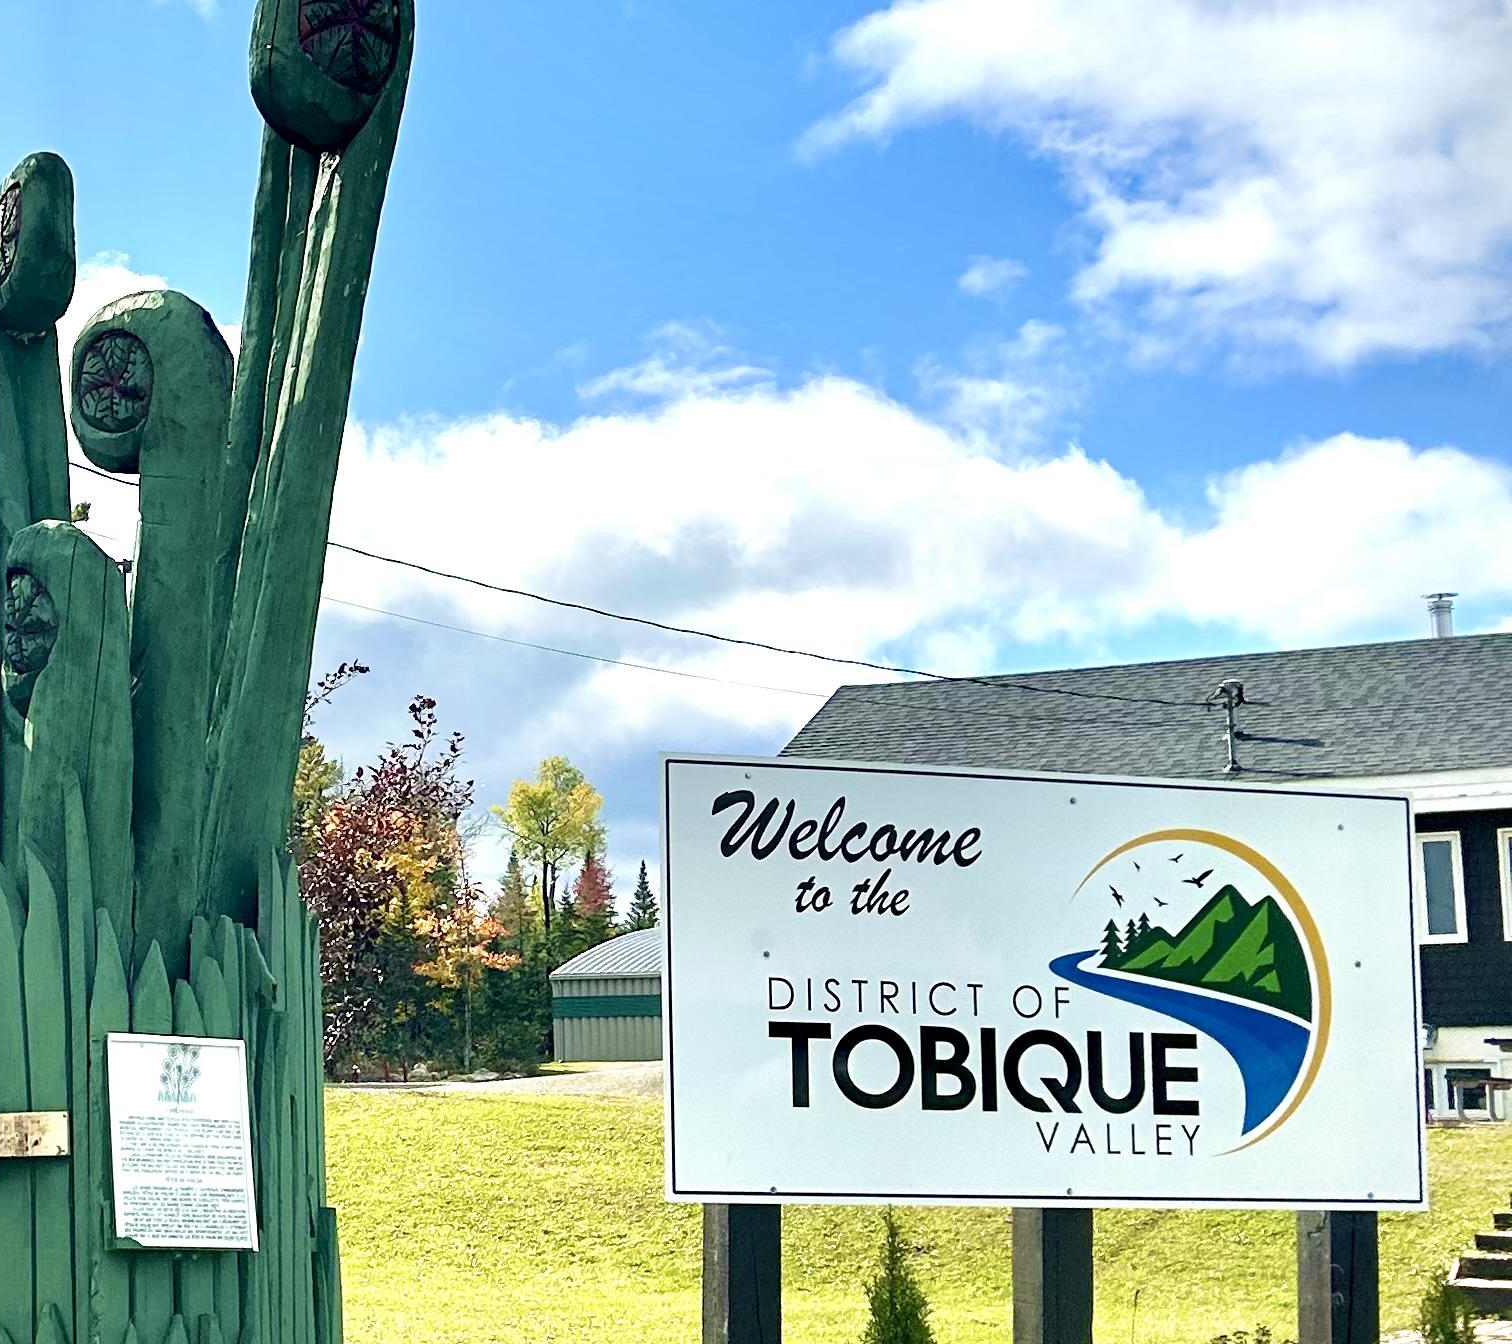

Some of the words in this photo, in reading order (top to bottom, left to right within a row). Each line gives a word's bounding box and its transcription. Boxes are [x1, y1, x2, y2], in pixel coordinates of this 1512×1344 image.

[712, 790, 982, 870] Welcome
[795, 876, 833, 912] to
[851, 868, 909, 916] the
[769, 978, 982, 1016] DISTRICT
[1013, 985, 1069, 1018] OF
[769, 1020, 1202, 1115] TOBIQUE
[1036, 1122, 1199, 1155] VALLEY
